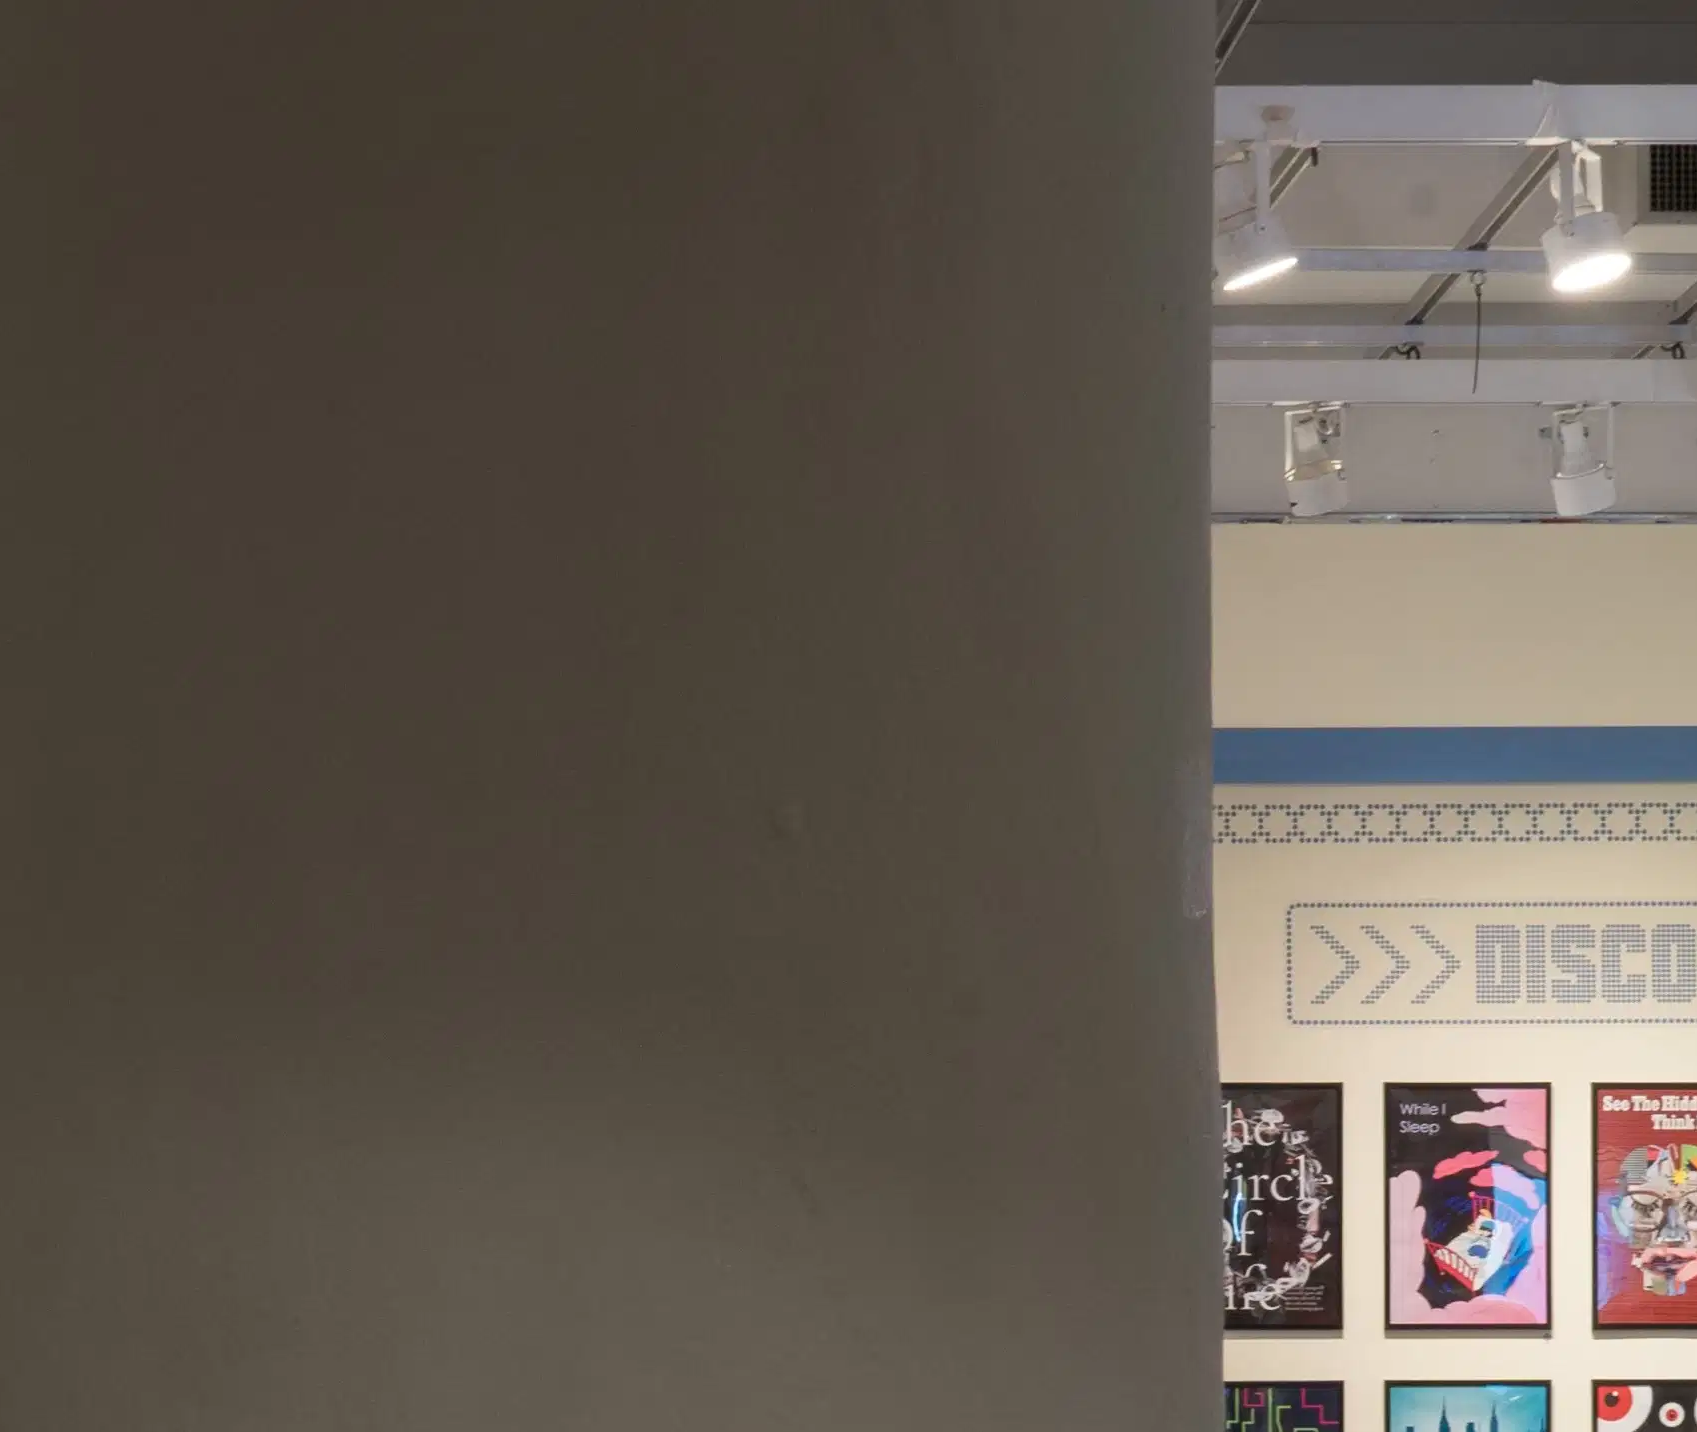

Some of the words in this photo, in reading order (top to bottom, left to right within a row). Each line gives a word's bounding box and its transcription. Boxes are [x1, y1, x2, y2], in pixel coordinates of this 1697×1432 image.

[1399, 1103, 1439, 1115] While
[1602, 1096, 1630, 1111] See
[1631, 1096, 1660, 1111] The
[1222, 1101, 1276, 1147] he
[1399, 1120, 1440, 1136] Sleep
[1651, 1114, 1695, 1130] Think
[1223, 1154, 1333, 1201] ircle
